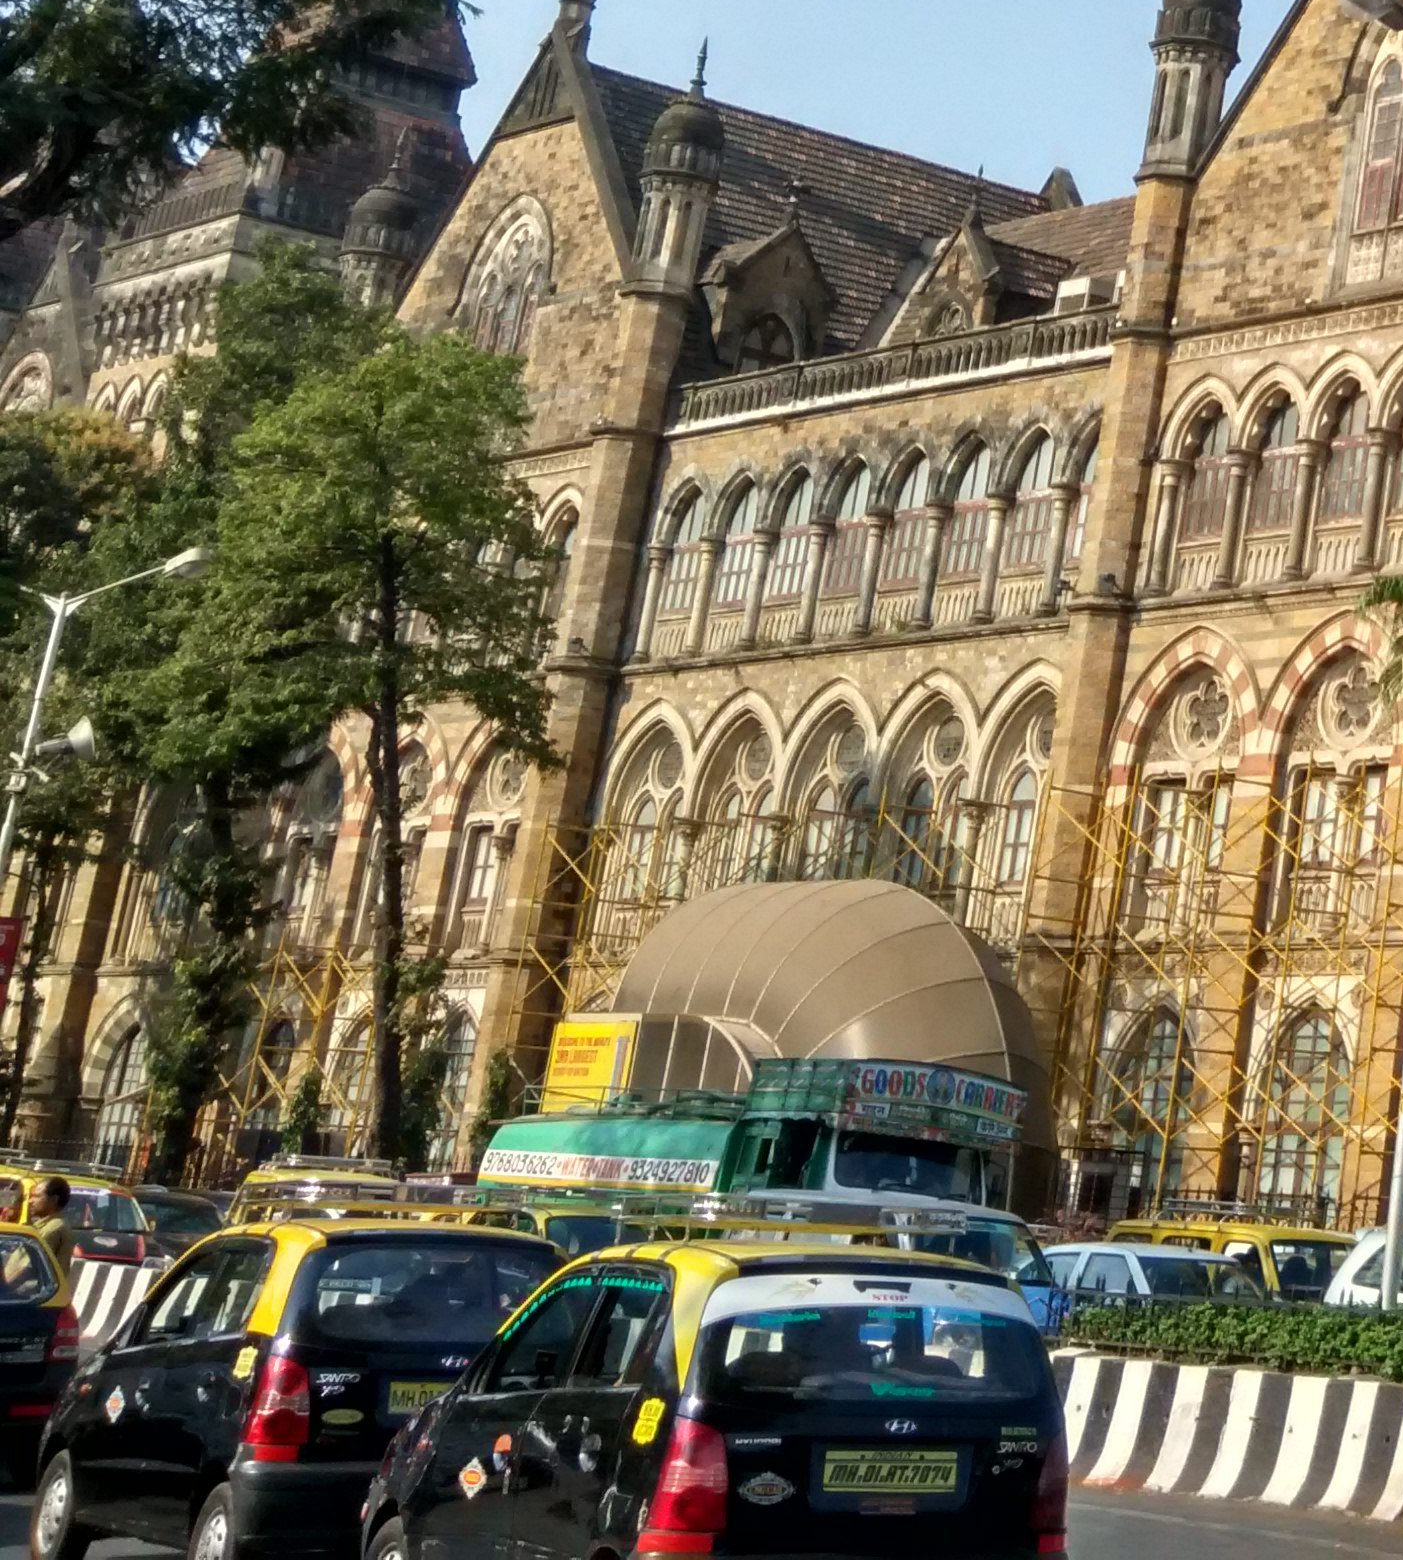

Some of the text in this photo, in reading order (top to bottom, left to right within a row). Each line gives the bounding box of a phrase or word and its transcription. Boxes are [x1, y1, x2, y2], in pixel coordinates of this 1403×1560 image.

[861, 1069, 928, 1100] GOODS
[484, 1152, 557, 1176] 9768036262
[627, 1160, 710, 1184] 9324927810
[872, 1293, 909, 1302] STOP
[316, 1373, 361, 1383] SANTRO
